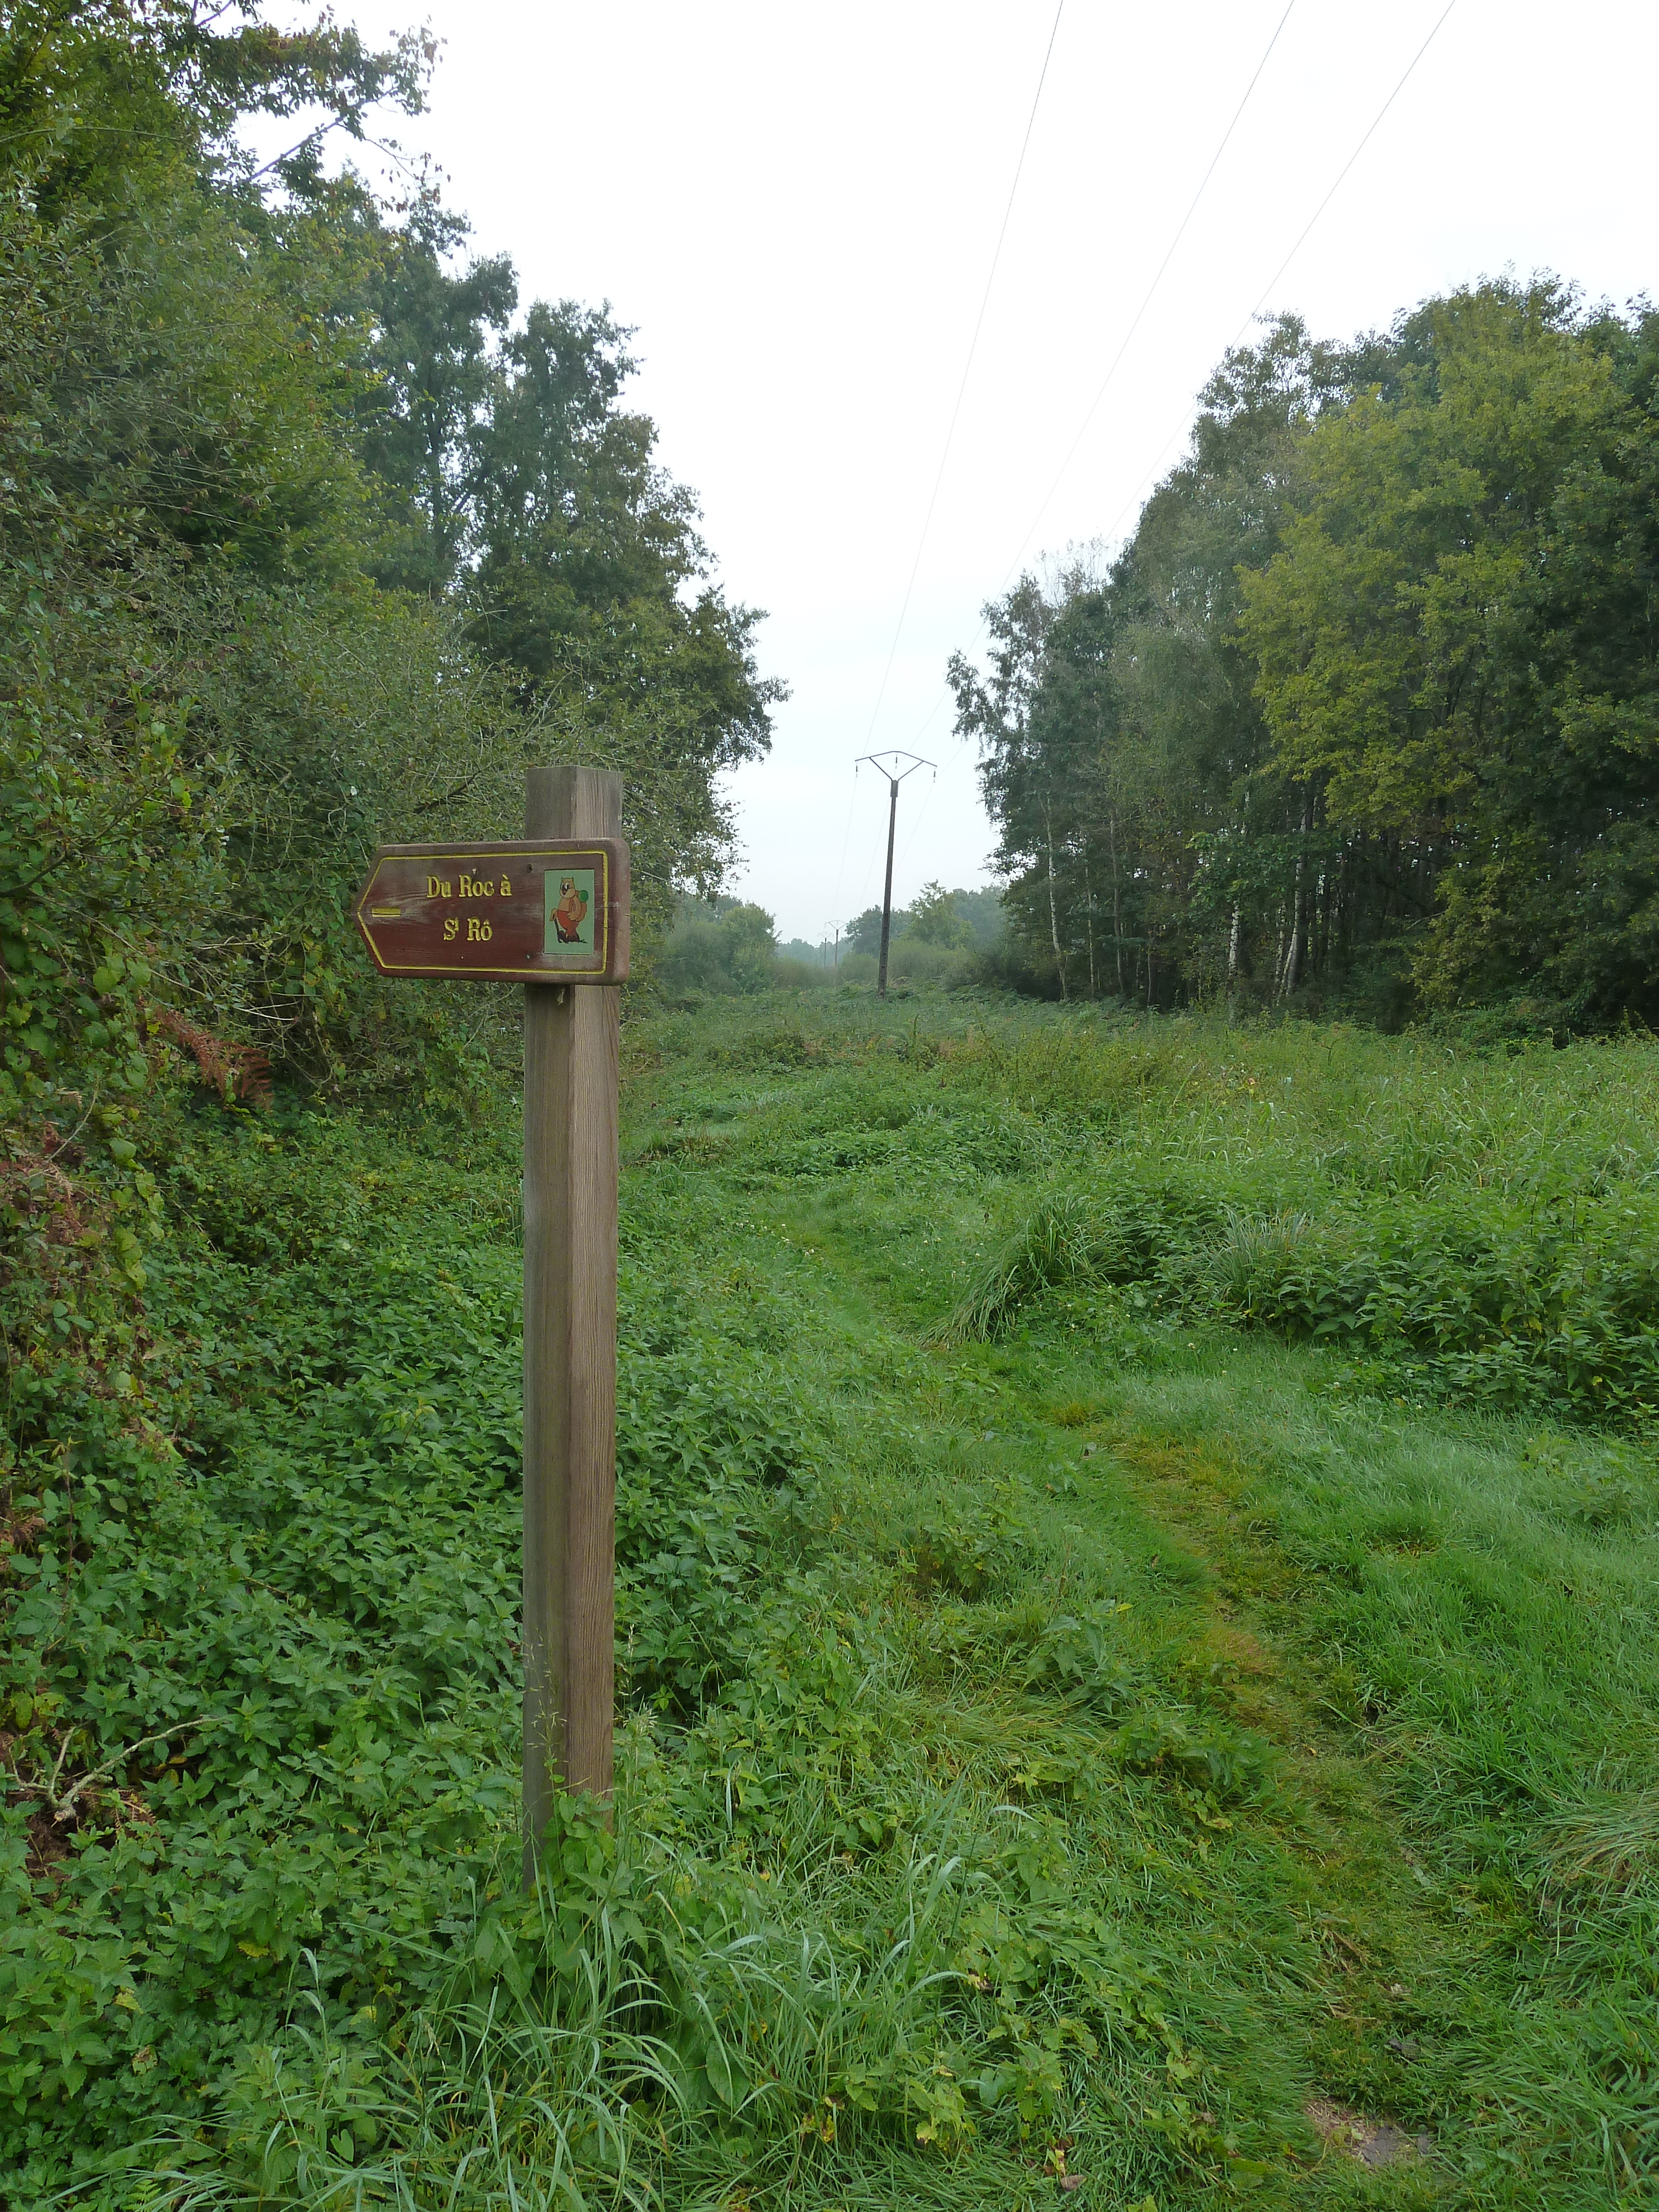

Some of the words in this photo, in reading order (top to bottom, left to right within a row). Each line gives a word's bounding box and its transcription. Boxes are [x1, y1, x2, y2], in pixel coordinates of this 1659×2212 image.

[426, 875, 452, 898] Du
[458, 874, 495, 898] Roc
[500, 874, 513, 897] à
[467, 917, 493, 942] Rô
